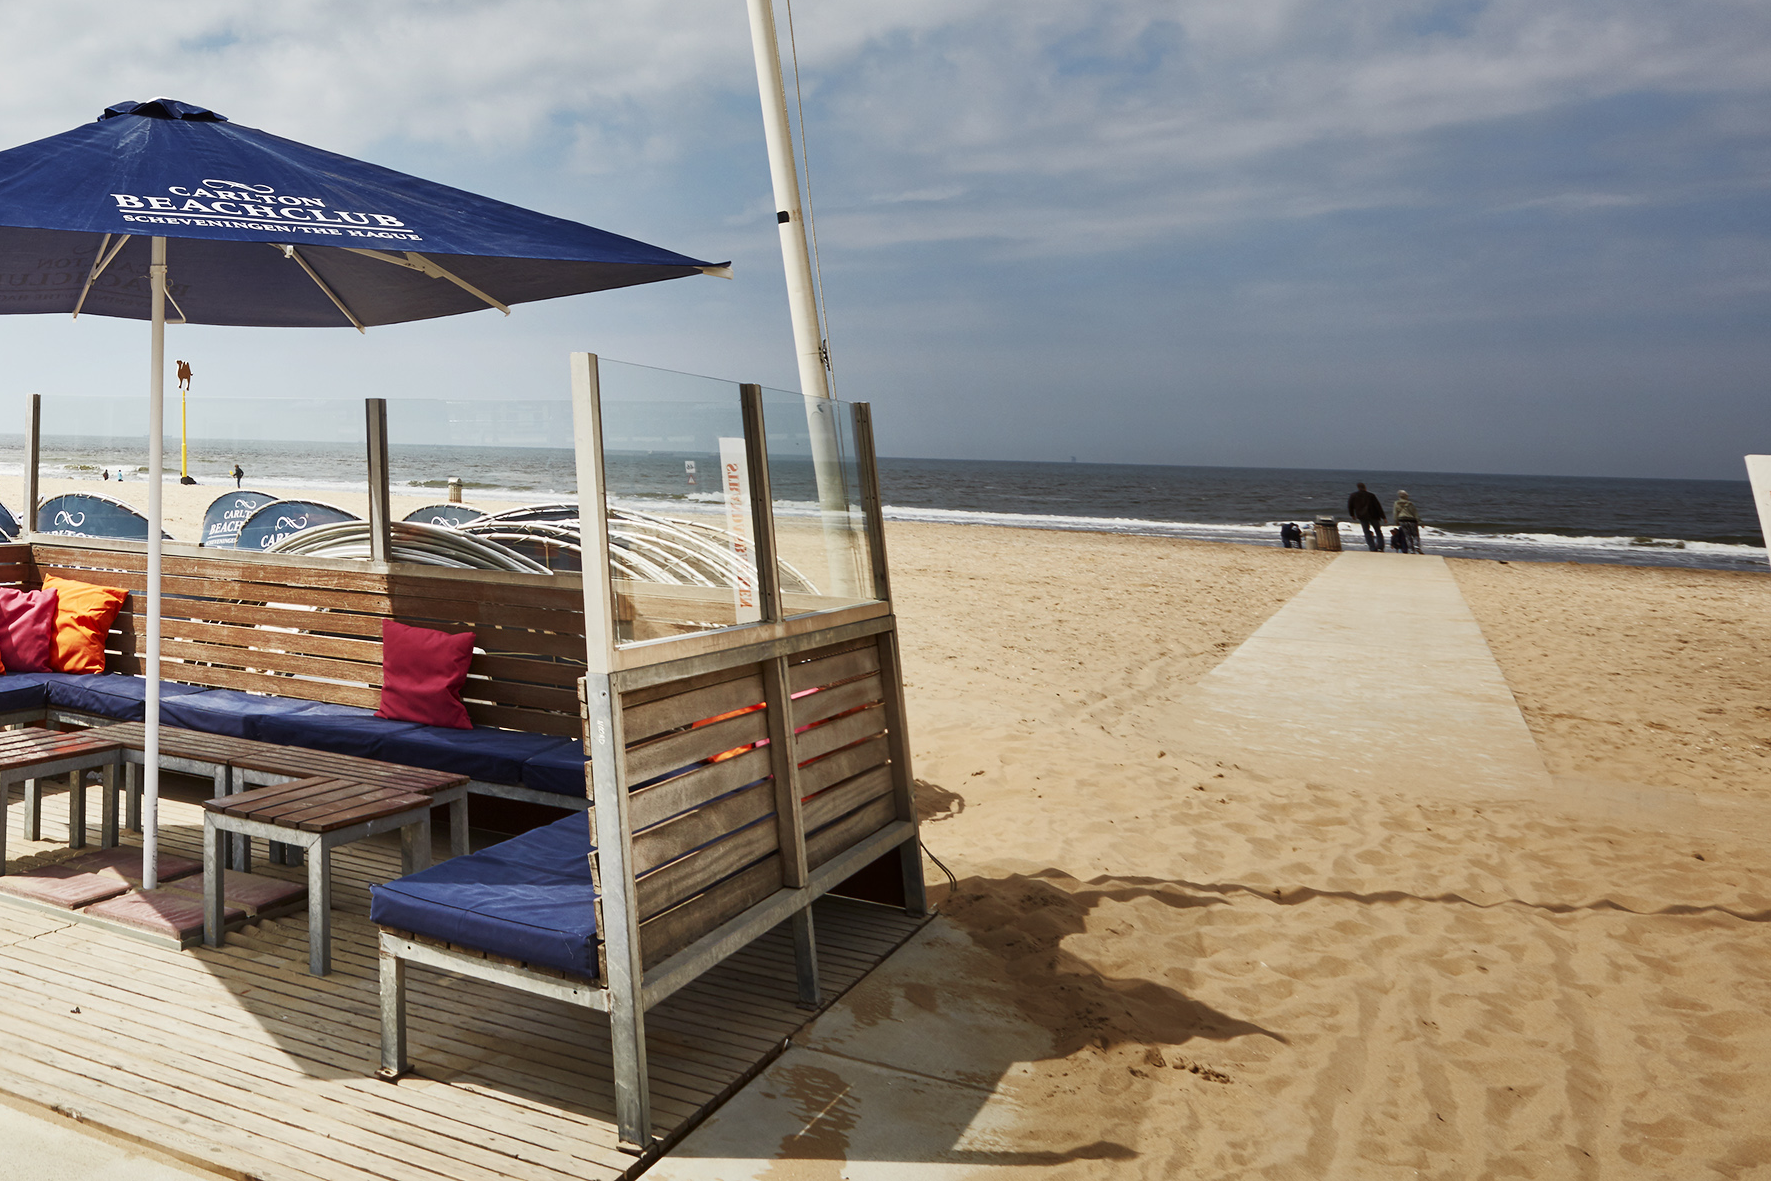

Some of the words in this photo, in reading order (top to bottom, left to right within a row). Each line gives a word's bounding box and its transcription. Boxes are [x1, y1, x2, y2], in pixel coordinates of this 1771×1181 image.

[168, 185, 326, 208] CARLTON
[110, 193, 406, 228] BEACHCLUB
[122, 214, 342, 236] SCHEVENINGEN/THE
[346, 228, 423, 242] HAGUE
[223, 509, 255, 519] CARLT
[209, 520, 246, 535] BEACH
